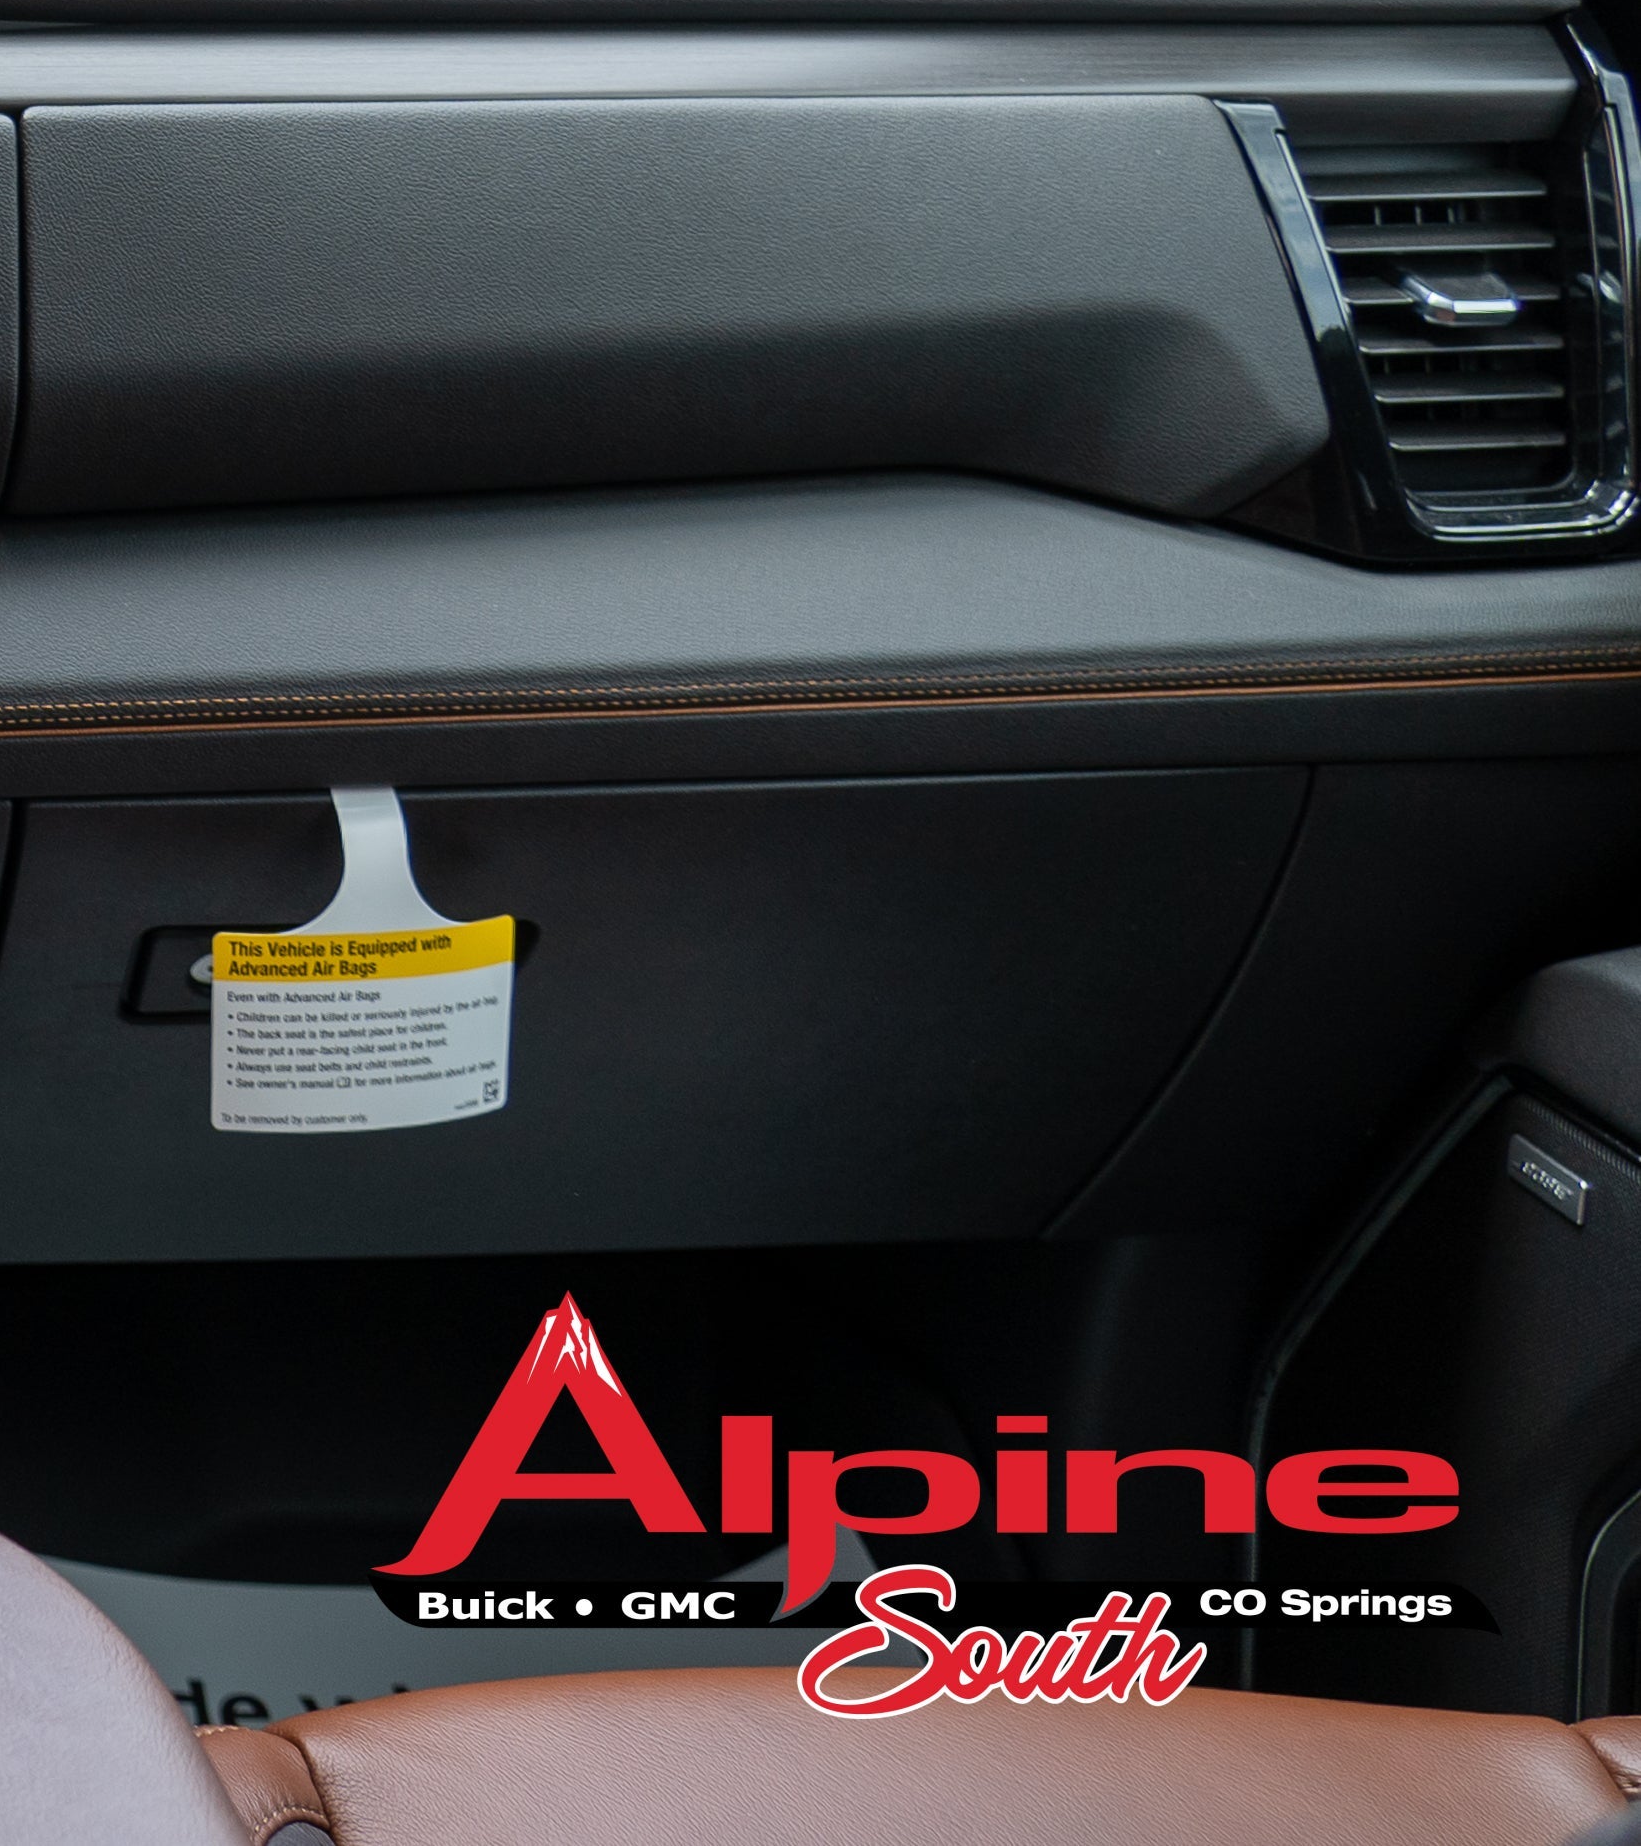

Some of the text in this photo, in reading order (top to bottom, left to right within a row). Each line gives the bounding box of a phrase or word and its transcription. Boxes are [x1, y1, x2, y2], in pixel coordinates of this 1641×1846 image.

[229, 934, 452, 957] This Vehicle is Equipped with
[228, 960, 378, 977] Advanced Air Bags
[227, 990, 381, 1002] Even with Advanced Air Bags
[236, 1011, 280, 1022] Children
[283, 1013, 302, 1022] can
[305, 1012, 318, 1022] be
[236, 1028, 255, 1039] The
[257, 1029, 281, 1039] back
[236, 1045, 266, 1055] Never
[268, 1046, 285, 1056] put
[235, 1061, 272, 1073] Always
[221, 1112, 232, 1123] To
